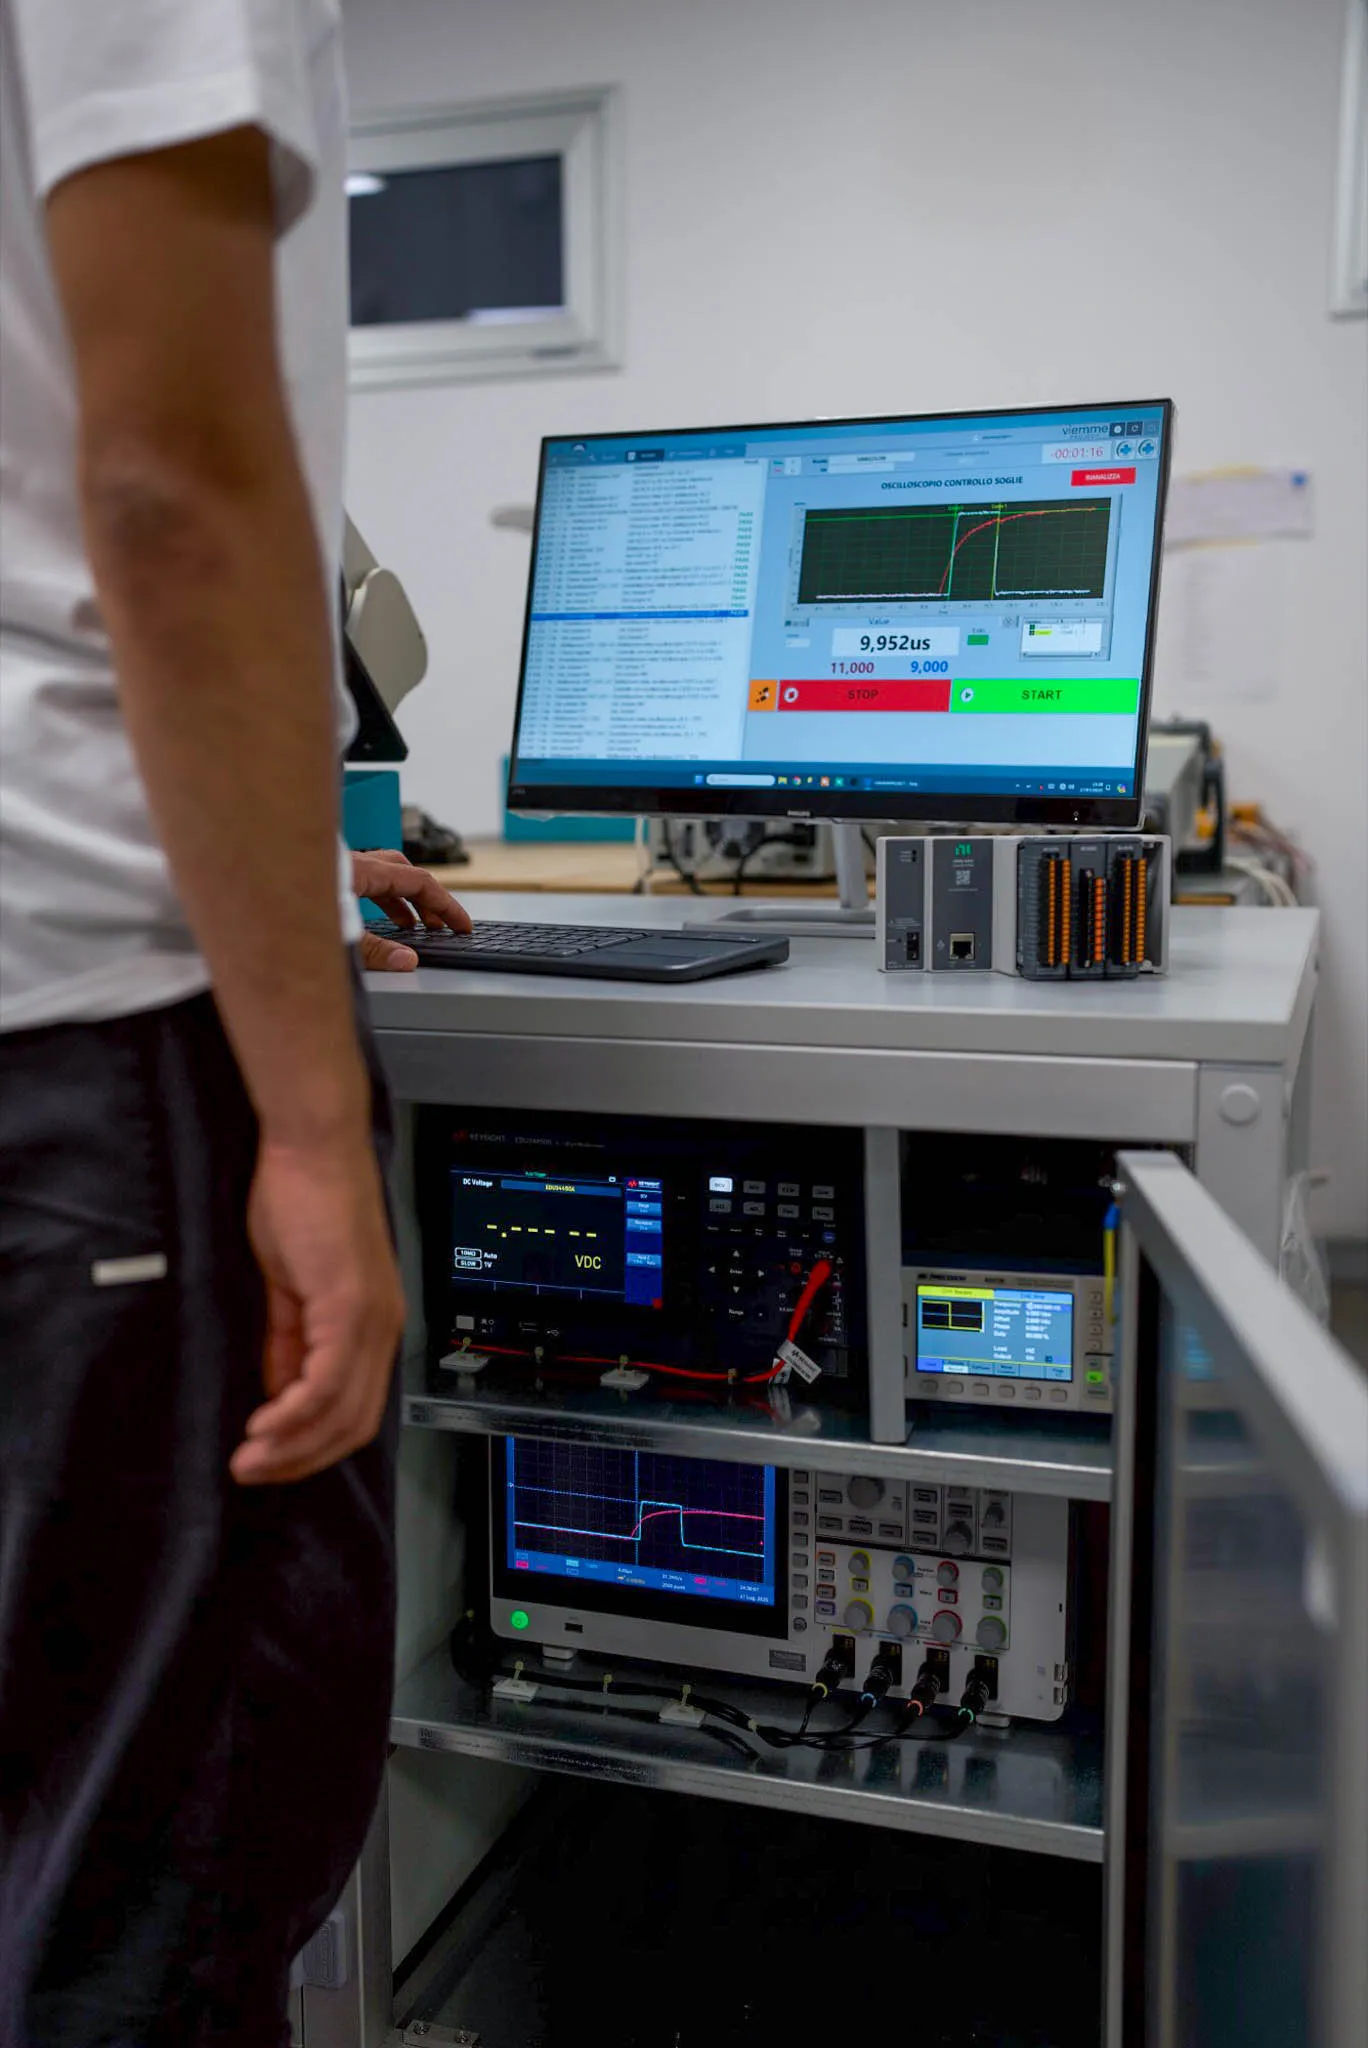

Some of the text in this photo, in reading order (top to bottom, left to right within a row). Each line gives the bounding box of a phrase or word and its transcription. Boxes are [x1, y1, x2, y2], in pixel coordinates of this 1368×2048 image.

[881, 476, 1024, 490] OSCILLOSCOPIO CONTROLLO SOGLIE
[860, 635, 931, 653] 9,952us
[831, 661, 949, 675] 11,000 9,000
[848, 689, 1063, 700] STOP START
[472, 1179, 493, 1188] Voltage
[574, 1254, 602, 1270] VDC
